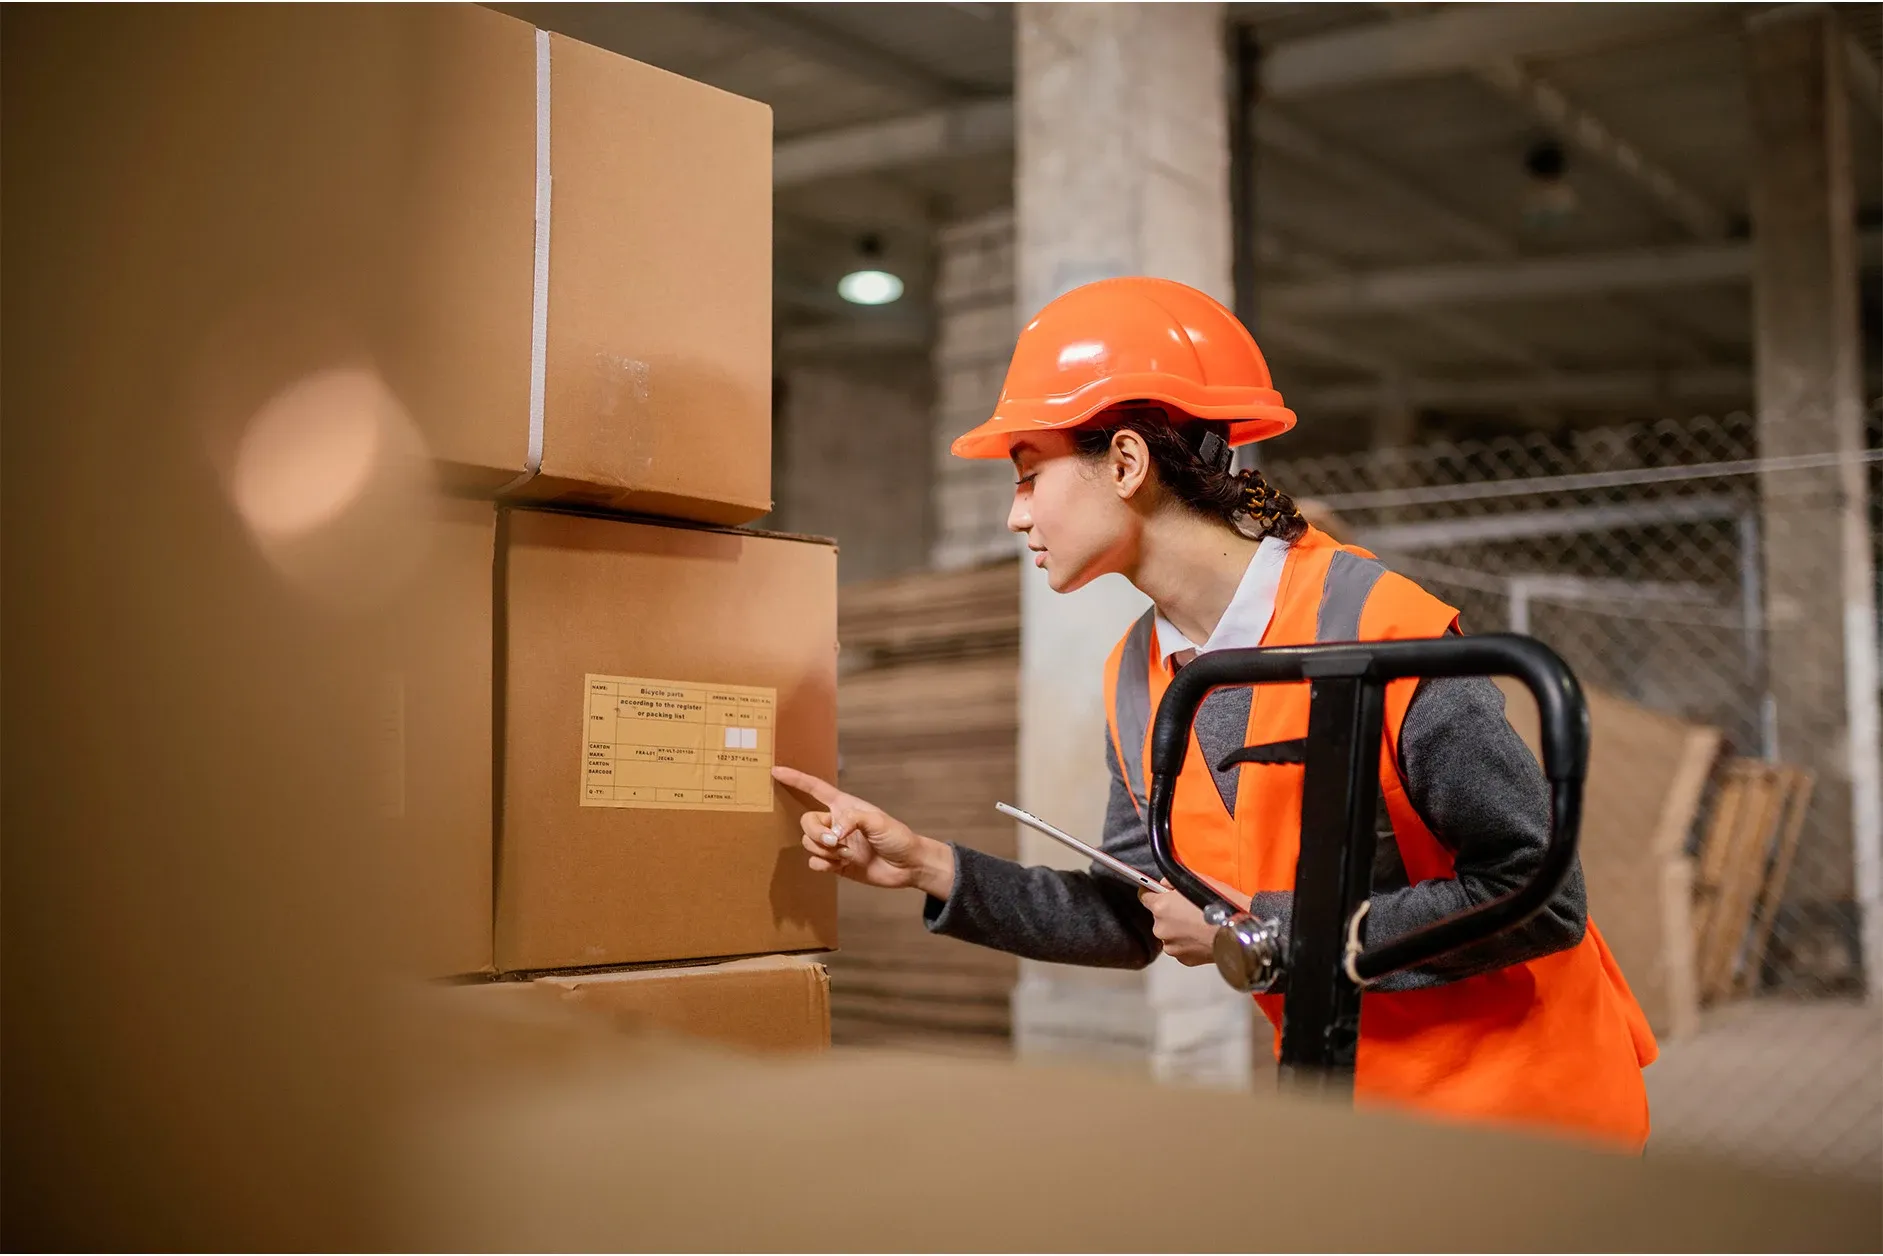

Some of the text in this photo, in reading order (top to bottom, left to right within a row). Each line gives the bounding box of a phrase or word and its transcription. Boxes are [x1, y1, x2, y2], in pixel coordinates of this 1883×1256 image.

[640, 688, 665, 697] Bicycle
[620, 699, 654, 707] according
[676, 703, 702, 711] register
[646, 711, 673, 719] packing
